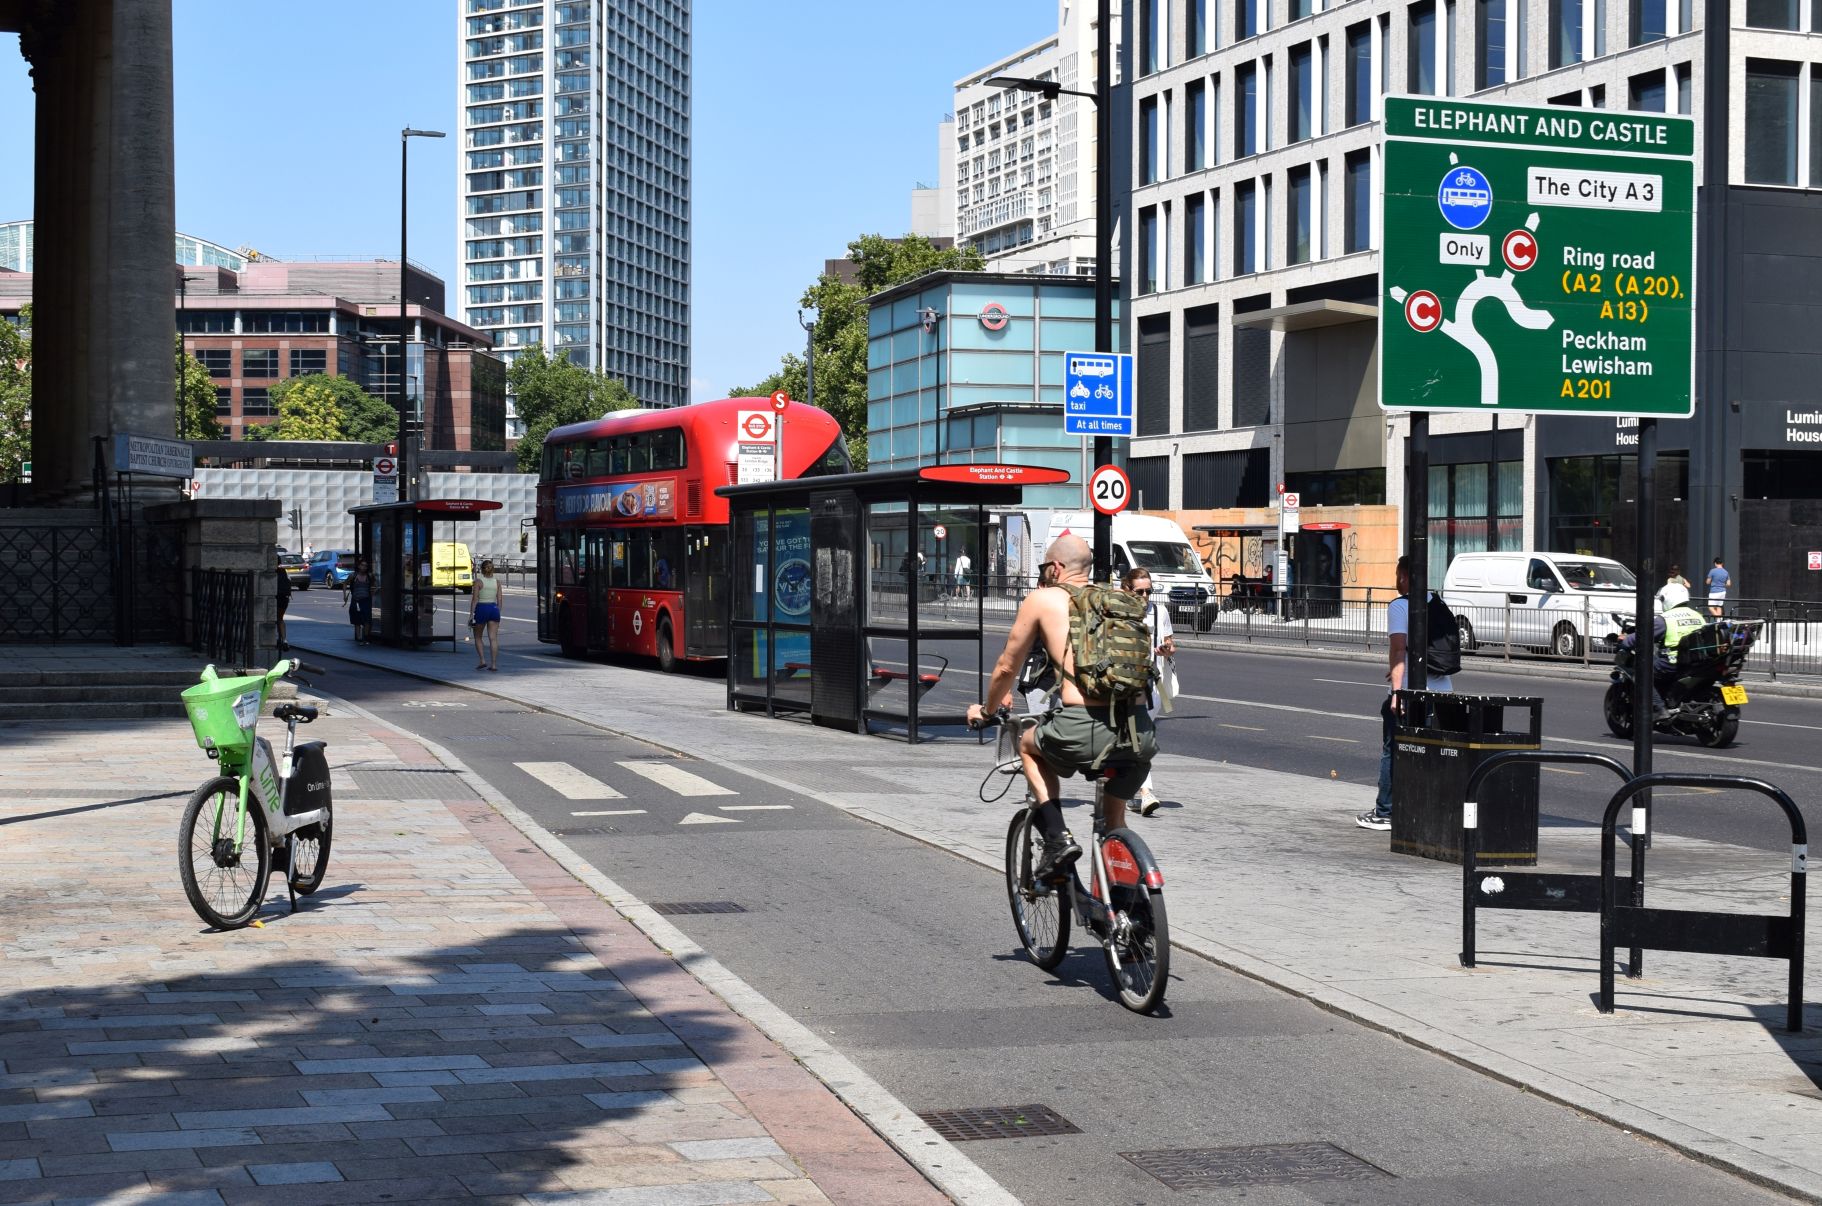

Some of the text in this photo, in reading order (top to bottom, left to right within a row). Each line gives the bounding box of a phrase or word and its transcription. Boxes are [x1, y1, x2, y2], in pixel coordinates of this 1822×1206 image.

[1414, 108, 1668, 144] ELEPHANT AND CASTLE
[1534, 176, 1570, 197] The
[1578, 180, 1618, 202] City
[1446, 240, 1484, 260] Only
[1563, 246, 1654, 270] Ring road
[1562, 270, 1684, 299] (A2 (A20),
[1600, 300, 1649, 323] A13)
[1562, 329, 1646, 351] Peckham
[1562, 355, 1653, 376] Lewisham
[1561, 379, 1611, 399] A201
[775, 393, 785, 409] S
[1070, 400, 1086, 411] taxi
[1076, 420, 1122, 430] At all times
[1616, 416, 1639, 428] Lumi
[1616, 432, 1639, 445] Hous
[387, 445, 394, 454] T
[1096, 479, 1125, 500] 20
[1398, 744, 1426, 754] RECYCLING
[1440, 748, 1458, 757] LITTER
[259, 763, 281, 814] Lime
